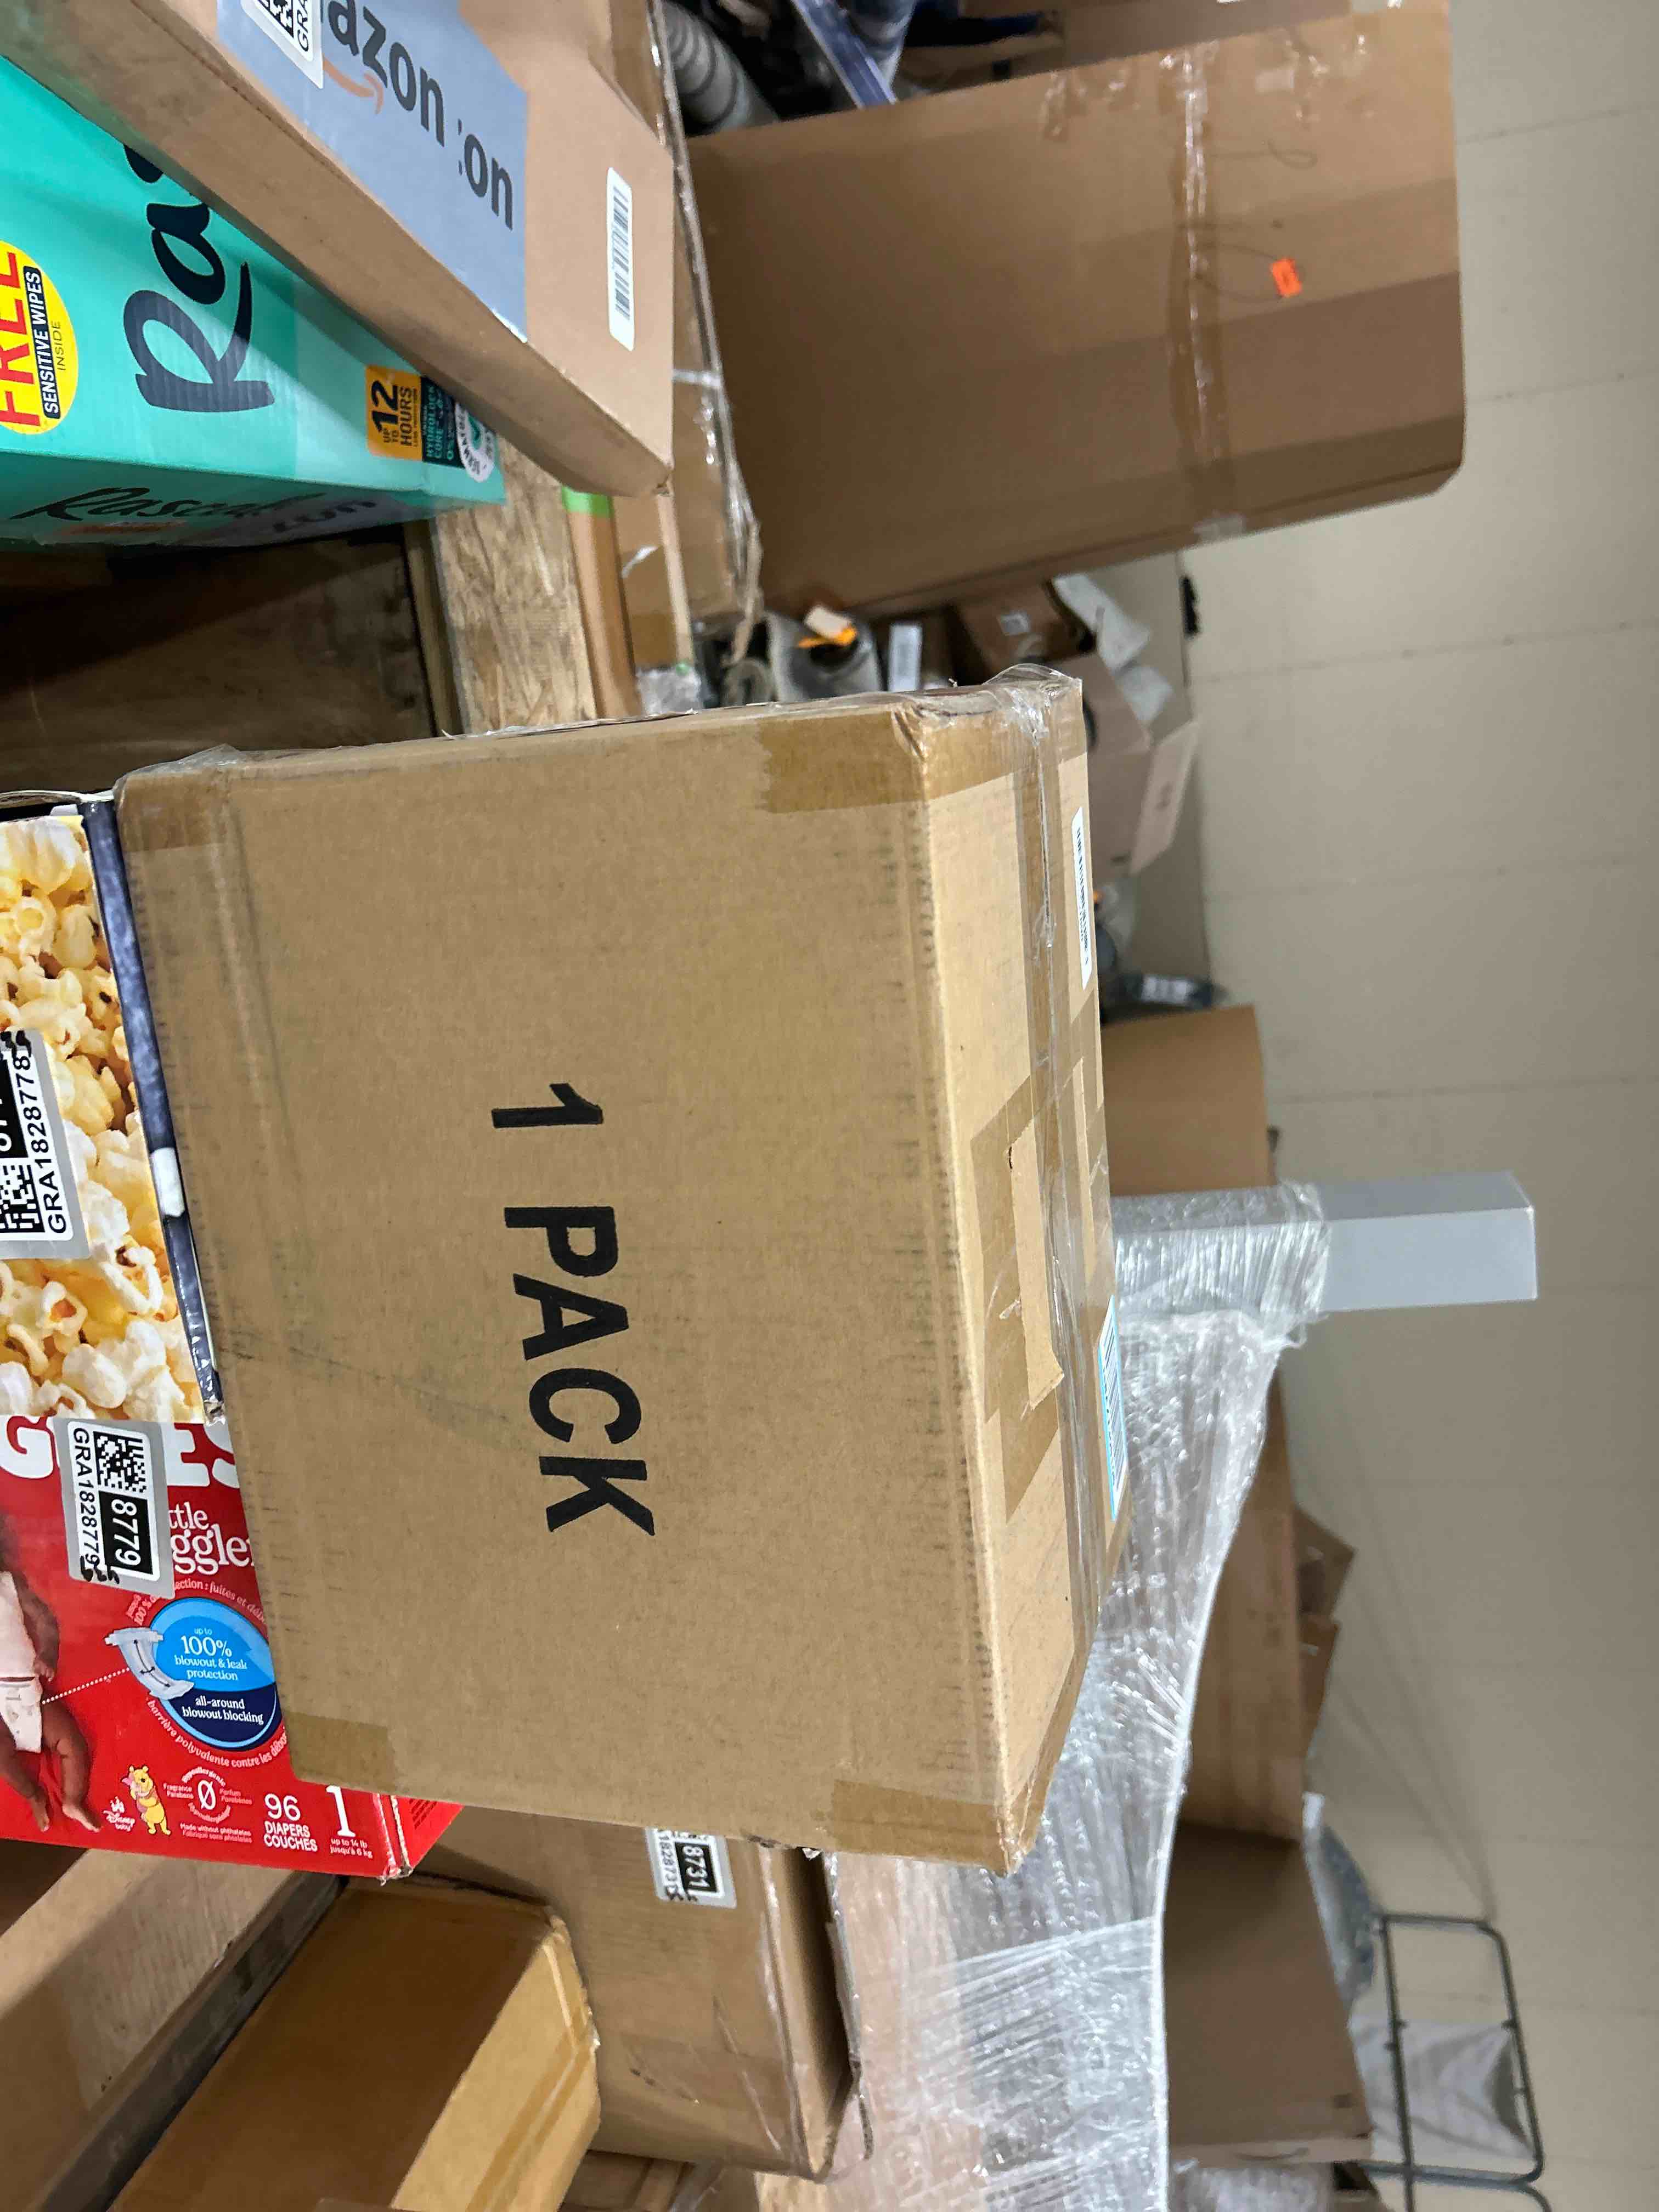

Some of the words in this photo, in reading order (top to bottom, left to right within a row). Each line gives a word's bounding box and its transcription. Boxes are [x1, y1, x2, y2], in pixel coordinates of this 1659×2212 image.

[322, 0, 444, 147] azon
[25, 271, 47, 325] WIPES
[50, 321, 66, 371] INSIDE
[33, 328, 59, 414] SENSITIVE
[371, 380, 398, 433] 12
[399, 386, 413, 447] HOURS
[491, 1083, 604, 1129] 1
[14, 1055, 67, 1234] GRA1828778
[504, 1206, 655, 1536] PACK
[72, 1427, 100, 1567] GRA1828779
[110, 1498, 142, 1566] 8779
[181, 1635, 232, 1657] 100%
[204, 1627, 213, 1635] to
[174, 1654, 217, 1668] blowout
[218, 1658, 226, 1669] &
[227, 1657, 248, 1670] leak
[187, 1669, 239, 1681] protection
[182, 1706, 222, 1720] blowout
[223, 1709, 264, 1726] blocking
[195, 1695, 245, 1709] all-around
[175, 1734, 230, 1767] polyvalente
[231, 1756, 261, 1768] contre
[259, 1751, 273, 1764] les
[264, 1793, 301, 1821] 96
[325, 1785, 356, 1838] 1
[263, 1833, 318, 1852] COUCHES
[264, 1821, 311, 1838] DIAPERS
[341, 1838, 350, 1847] to
[359, 1839, 368, 1848] lb
[682, 1846, 711, 1888] 8731
